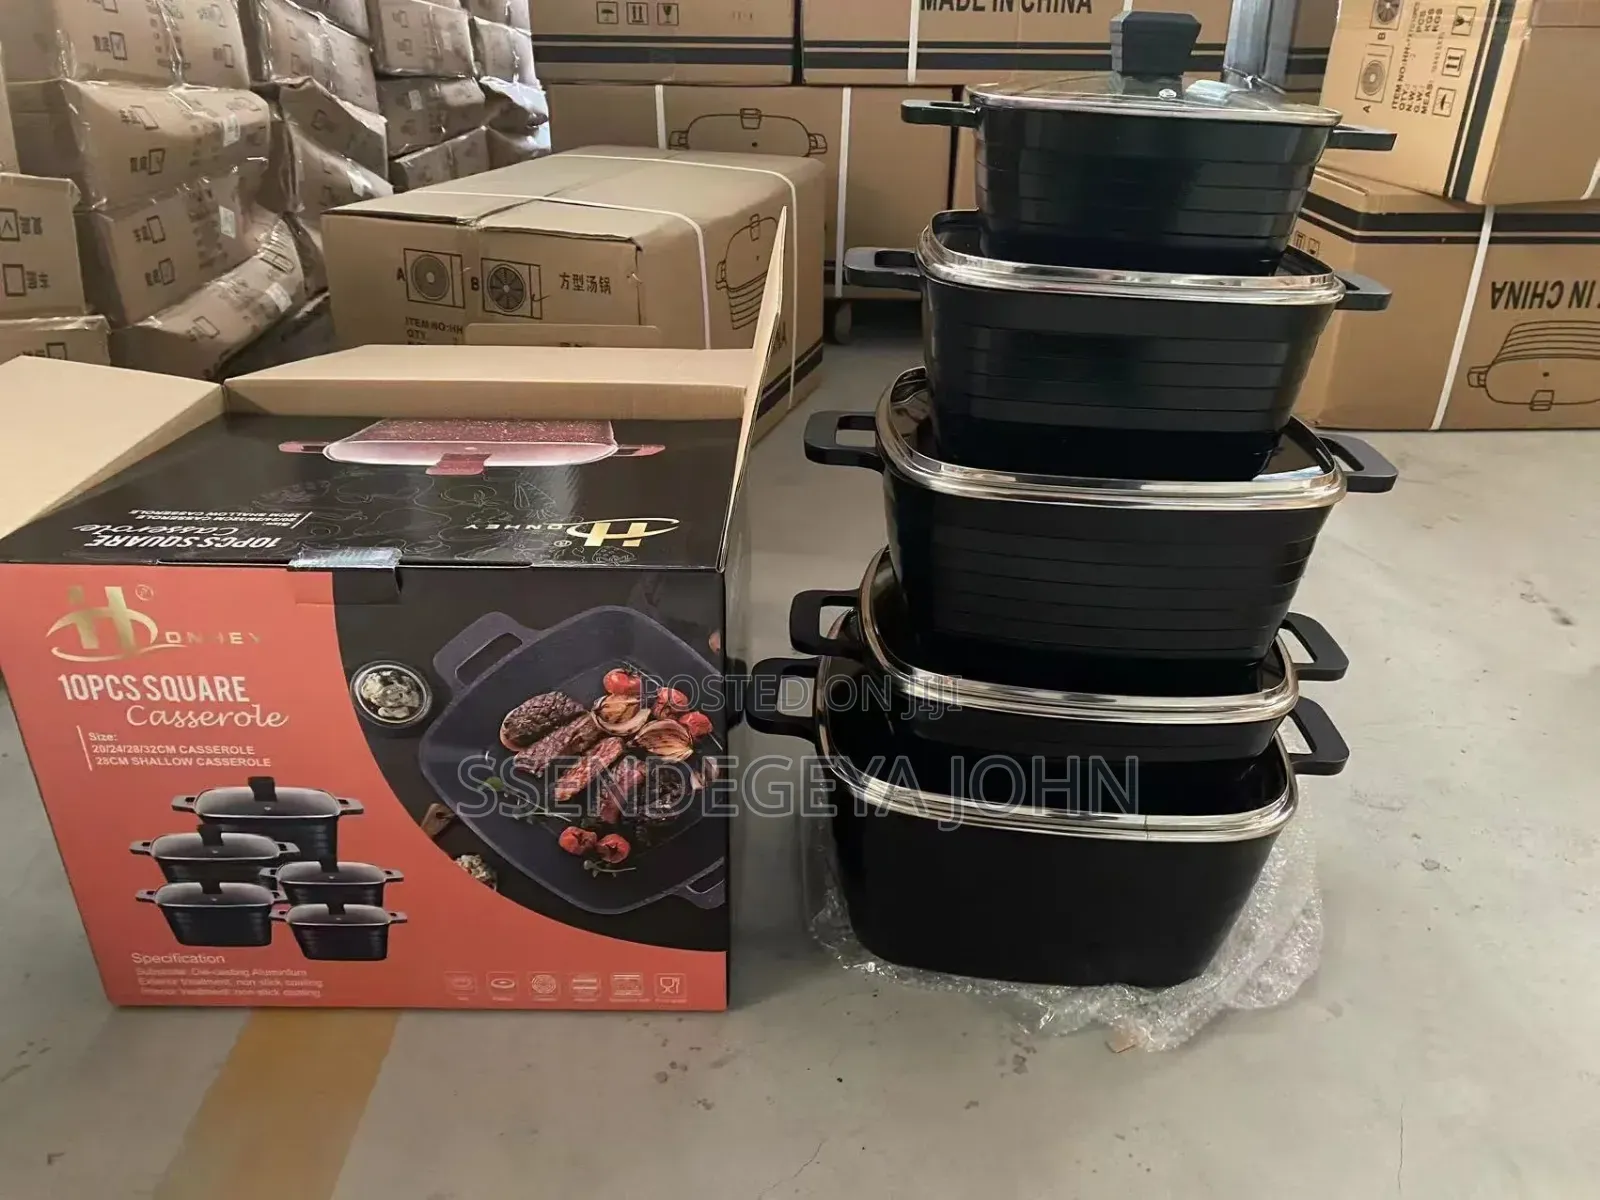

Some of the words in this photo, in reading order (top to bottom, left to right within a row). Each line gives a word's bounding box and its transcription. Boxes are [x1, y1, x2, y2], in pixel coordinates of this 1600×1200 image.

[1424, 8, 1434, 32] KGS
[1432, 8, 1442, 32] KGS
[1377, 32, 1386, 40] B
[1392, 84, 1402, 109] ITEM
[1363, 105, 1371, 113] A
[397, 268, 405, 281] A
[470, 277, 479, 291] B
[558, 272, 612, 295] 方型汤锅
[1491, 280, 1564, 310] CHINA
[1568, 280, 1596, 309] IN
[405, 316, 429, 329] ITEM
[72, 524, 239, 536] Casserole
[84, 535, 200, 547] SQUARE
[197, 536, 282, 548] 10PCS
[58, 674, 141, 701] 10PCS
[143, 674, 250, 703] SQUARE
[126, 704, 289, 729] Casserole
[88, 732, 118, 741] Size:
[92, 744, 176, 754] 20/24/28/32CM
[179, 745, 255, 755] CASSEROLE
[95, 757, 130, 766] 28CM
[132, 757, 193, 767] SHALLOW
[196, 758, 272, 768] CASSEROLE
[131, 953, 226, 965] Specification
